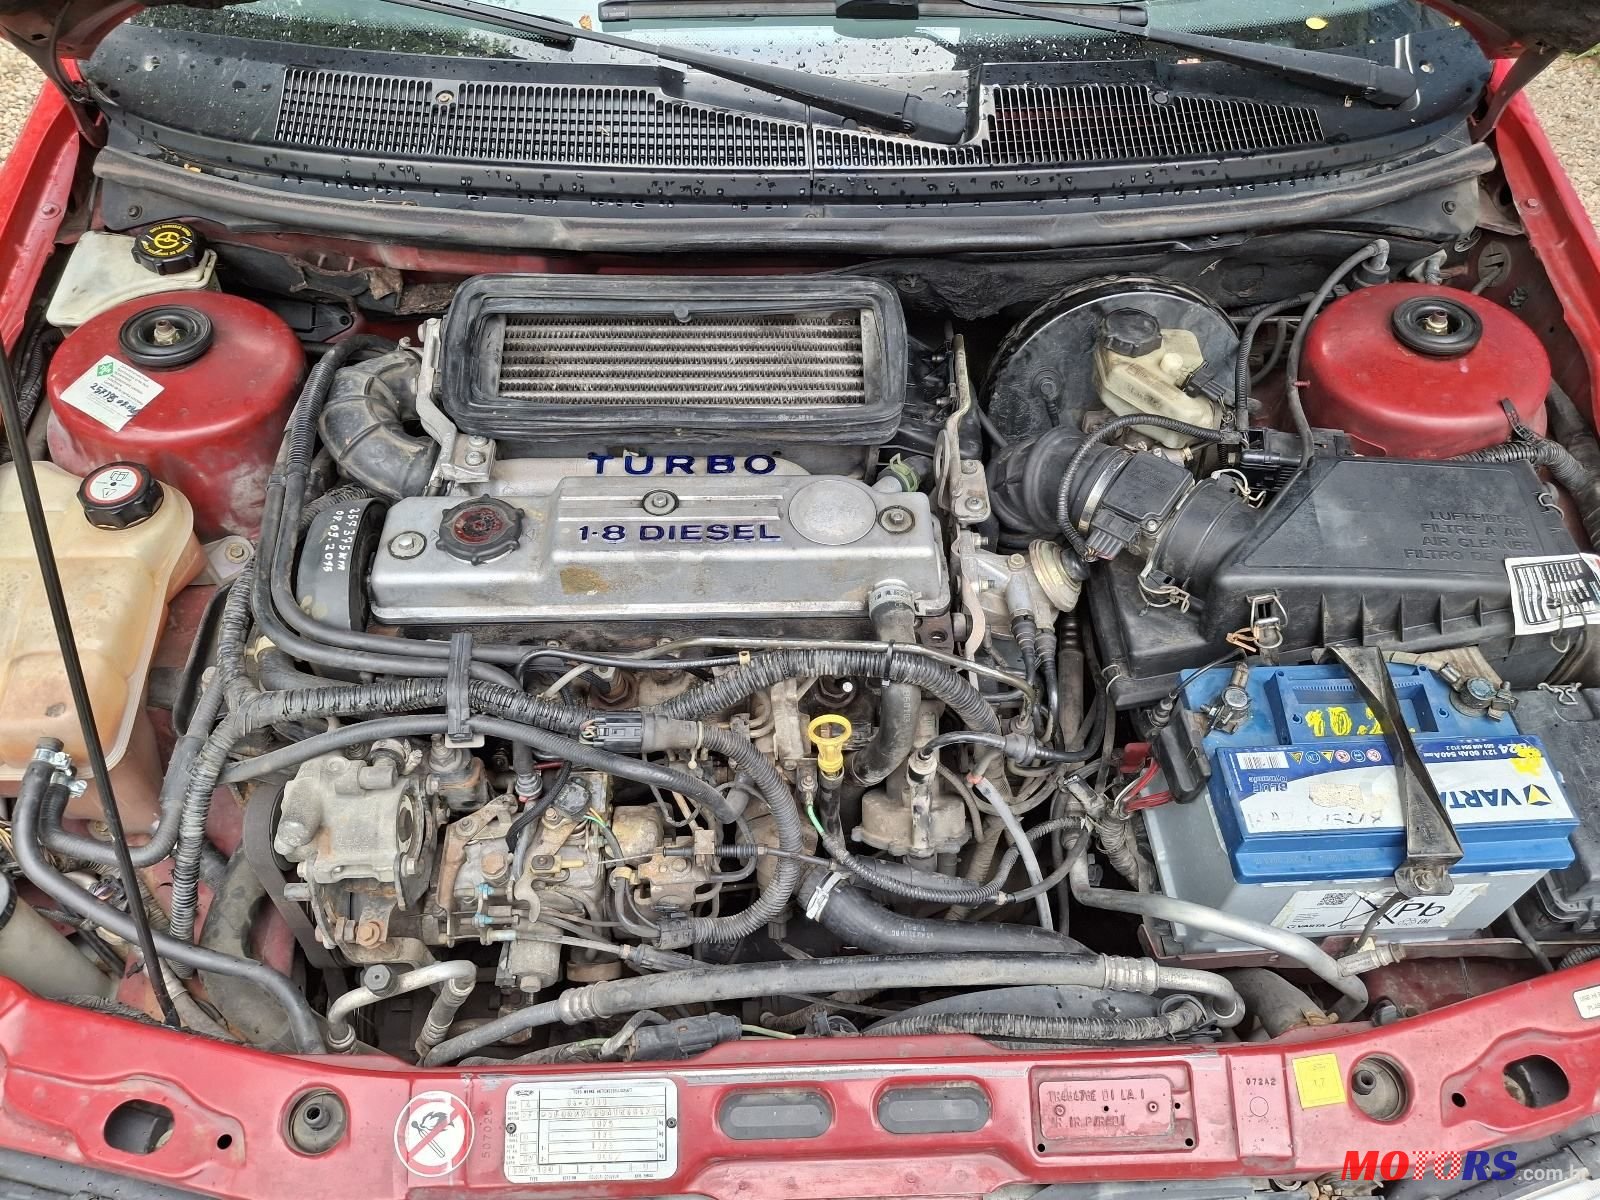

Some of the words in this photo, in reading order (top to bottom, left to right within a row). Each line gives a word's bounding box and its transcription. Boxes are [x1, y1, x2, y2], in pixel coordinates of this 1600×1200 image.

[588, 453, 777, 475] TURBO
[639, 524, 781, 542] DIESEL
[1420, 522, 1479, 535] FILTRE
[1503, 526, 1529, 538] AIR
[1422, 536, 1451, 547] AIR
[1457, 538, 1535, 551] CLEANER
[1403, 548, 1461, 562] FILTRO
[1470, 551, 1497, 562] DE
[1252, 782, 1288, 793] BLUE
[1393, 902, 1446, 918] Pb
